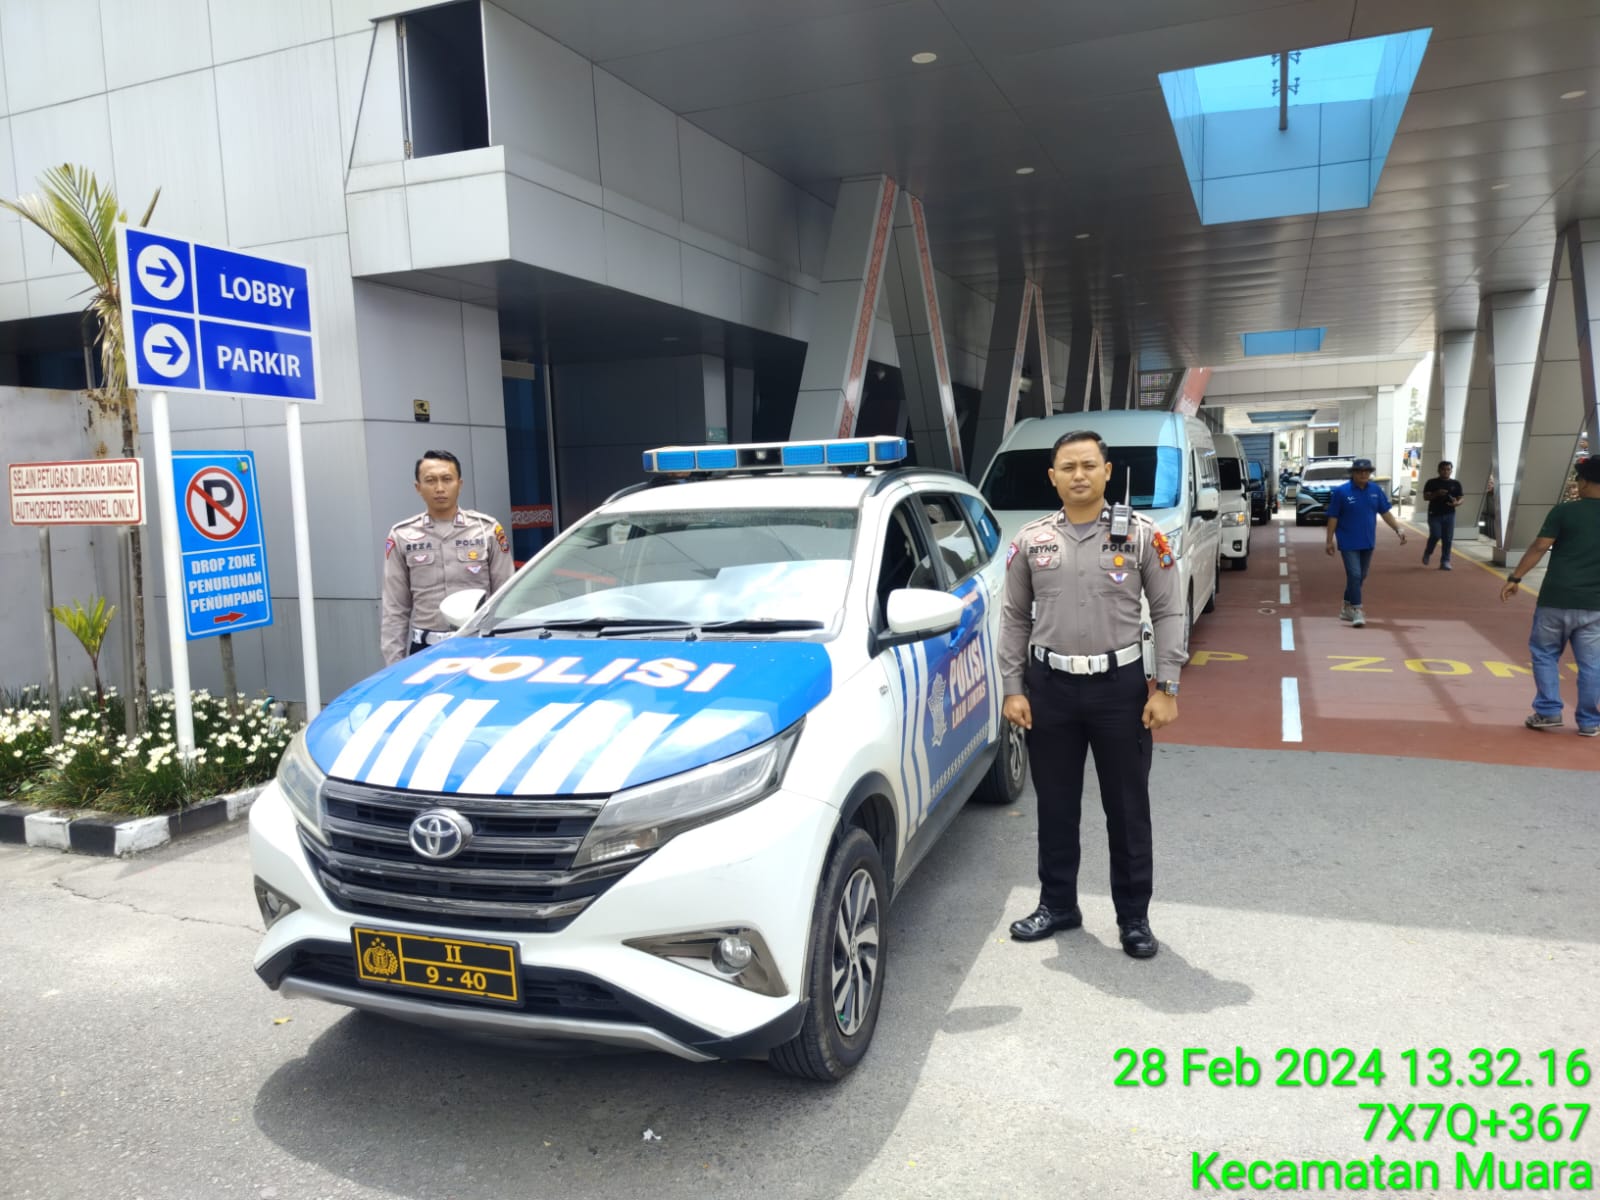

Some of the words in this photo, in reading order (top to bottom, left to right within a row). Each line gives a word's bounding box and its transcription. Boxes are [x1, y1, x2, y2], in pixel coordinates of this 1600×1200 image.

[219, 273, 295, 310] LOBBY
[216, 345, 301, 378] PARKIR
[13, 469, 36, 490] SELAIN
[37, 468, 69, 489] PETUGAS
[70, 466, 106, 488] DILARANG
[107, 465, 134, 487] MASUK
[15, 501, 62, 519] AUTHORIZED
[63, 500, 112, 519] PERSONNEL
[113, 499, 135, 518] ONLY
[456, 539, 484, 547] POLRI
[1029, 544, 1060, 554] REYNO
[1102, 543, 1136, 553] POLRI
[191, 557, 226, 575] DROP
[227, 553, 257, 569] ZONE
[188, 571, 263, 595] PENURUNAN
[190, 588, 265, 614] PENUMPANG
[402, 655, 736, 693] POLISI
[949, 634, 986, 706] POLISI
[1326, 654, 1579, 680] ZON
[444, 944, 463, 964] II
[425, 966, 440, 984] 9
[460, 970, 488, 990] 40
